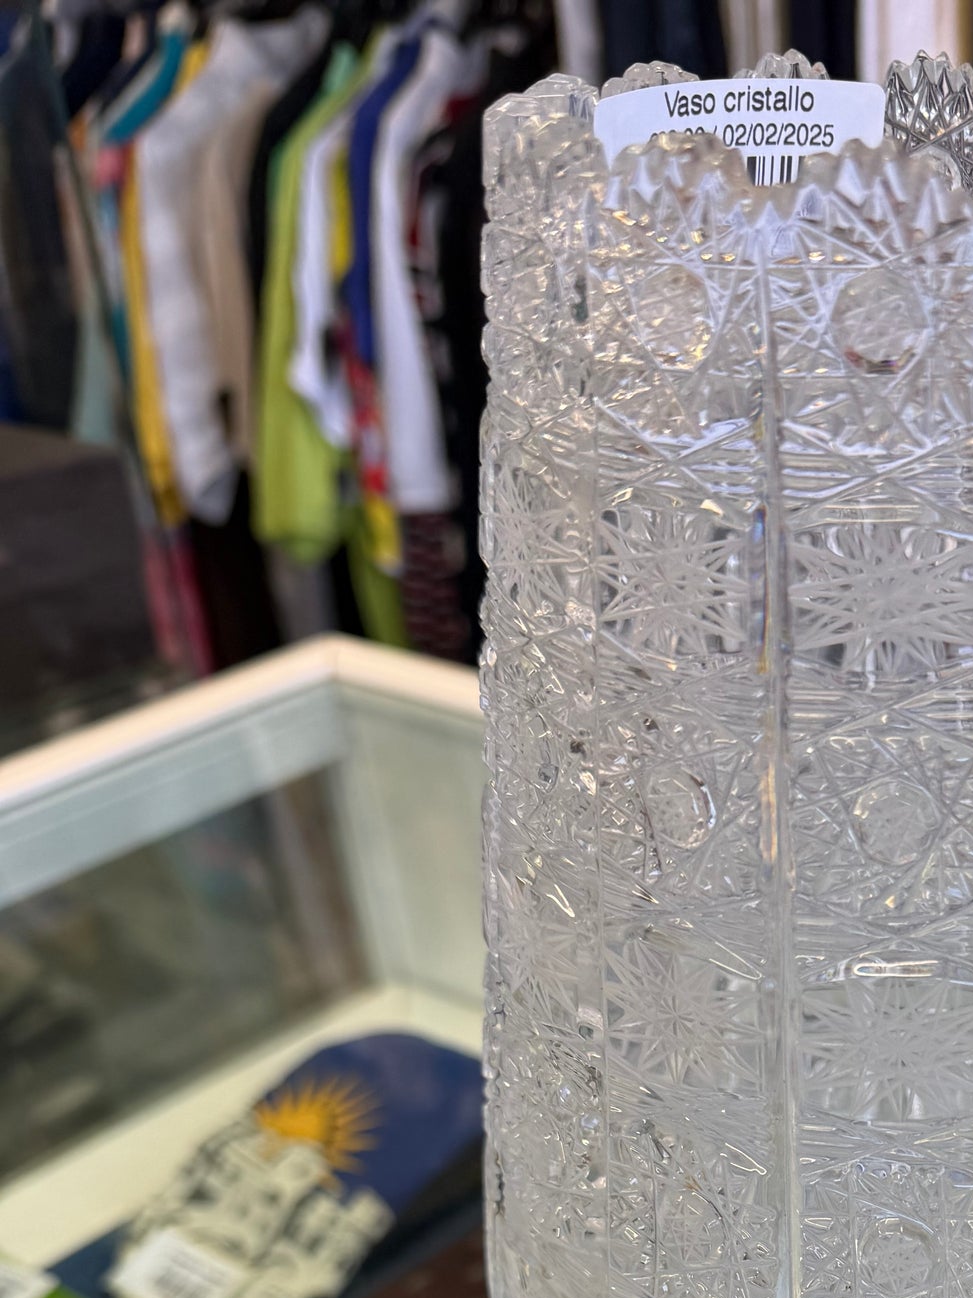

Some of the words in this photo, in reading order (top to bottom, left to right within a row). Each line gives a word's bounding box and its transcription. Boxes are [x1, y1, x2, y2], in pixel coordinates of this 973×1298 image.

[665, 90, 716, 118] Vaso
[723, 85, 815, 113] cristallo
[722, 123, 835, 148] 02/02/2025
